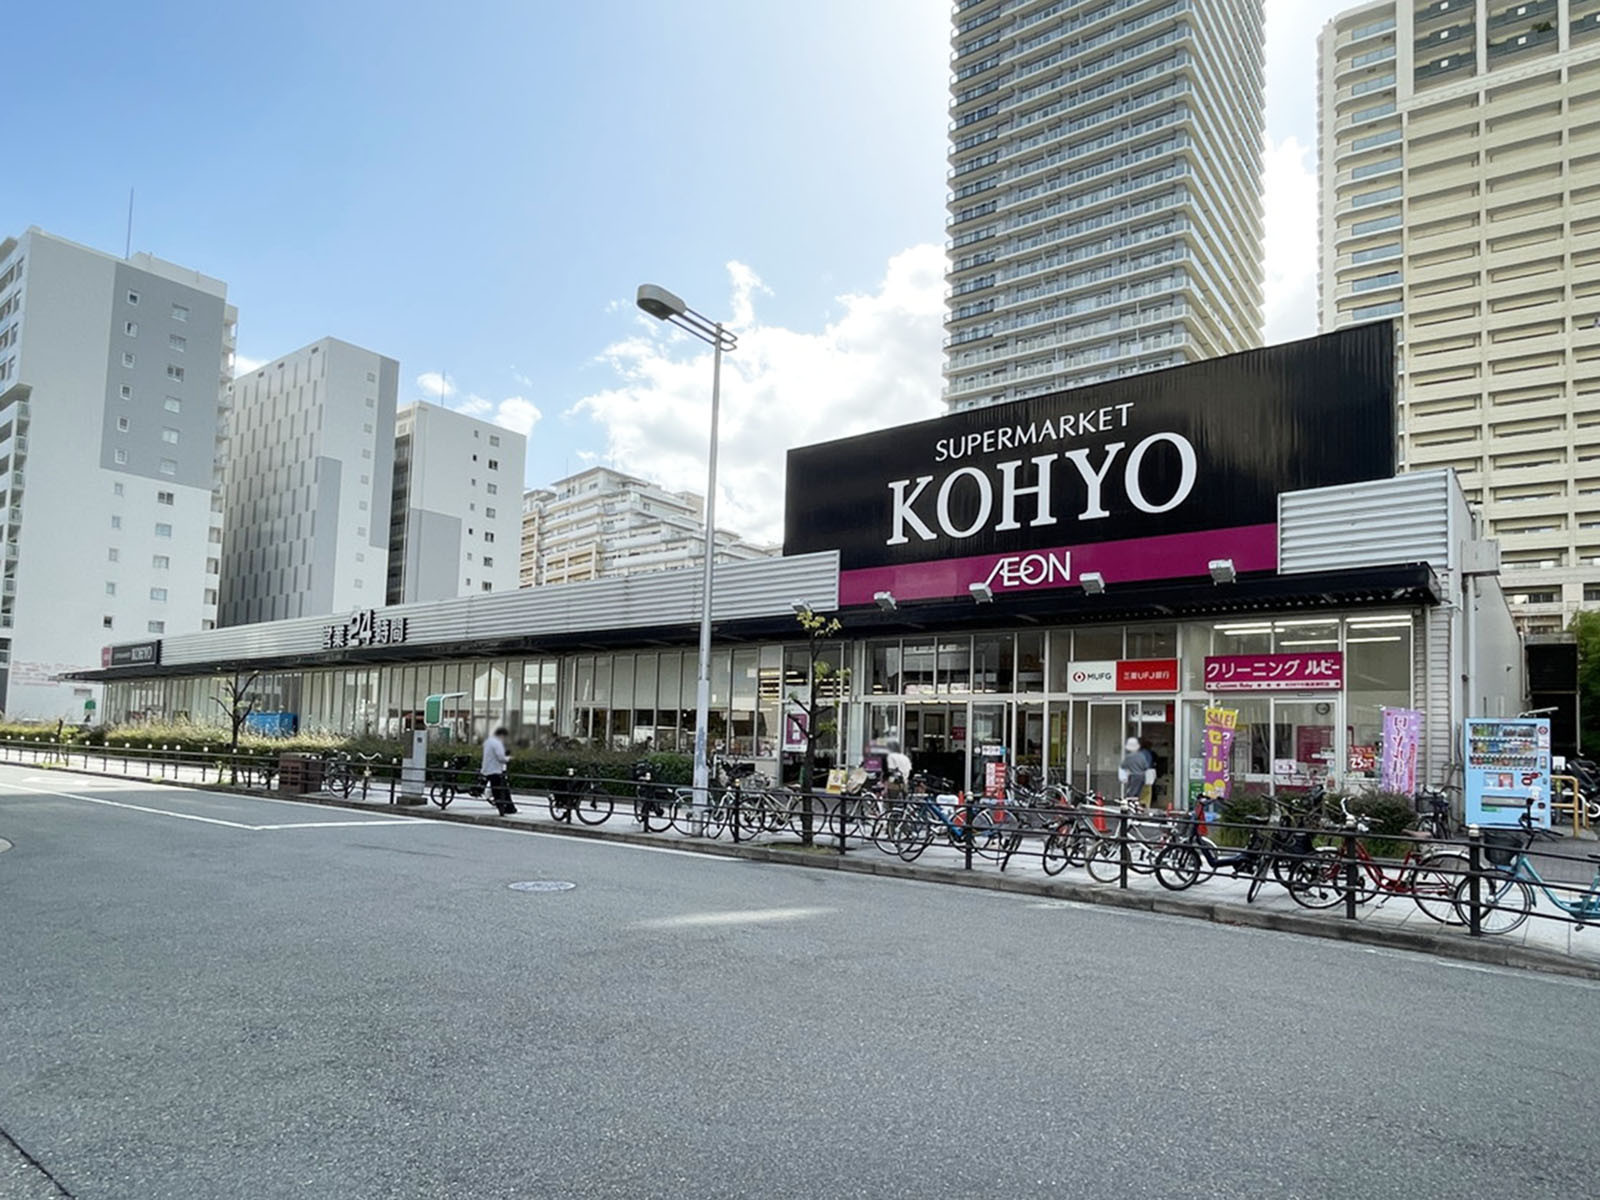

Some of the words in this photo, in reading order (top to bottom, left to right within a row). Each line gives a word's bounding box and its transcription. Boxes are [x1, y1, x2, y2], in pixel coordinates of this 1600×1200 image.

[935, 402, 1135, 462] SUPERMARKET
[886, 432, 1198, 546] KOHYO
[1087, 672, 1112, 680] MUFG
[1206, 659, 1300, 679] クリーニング
[1304, 659, 1340, 676] ルビー
[1208, 730, 1222, 772] セール
